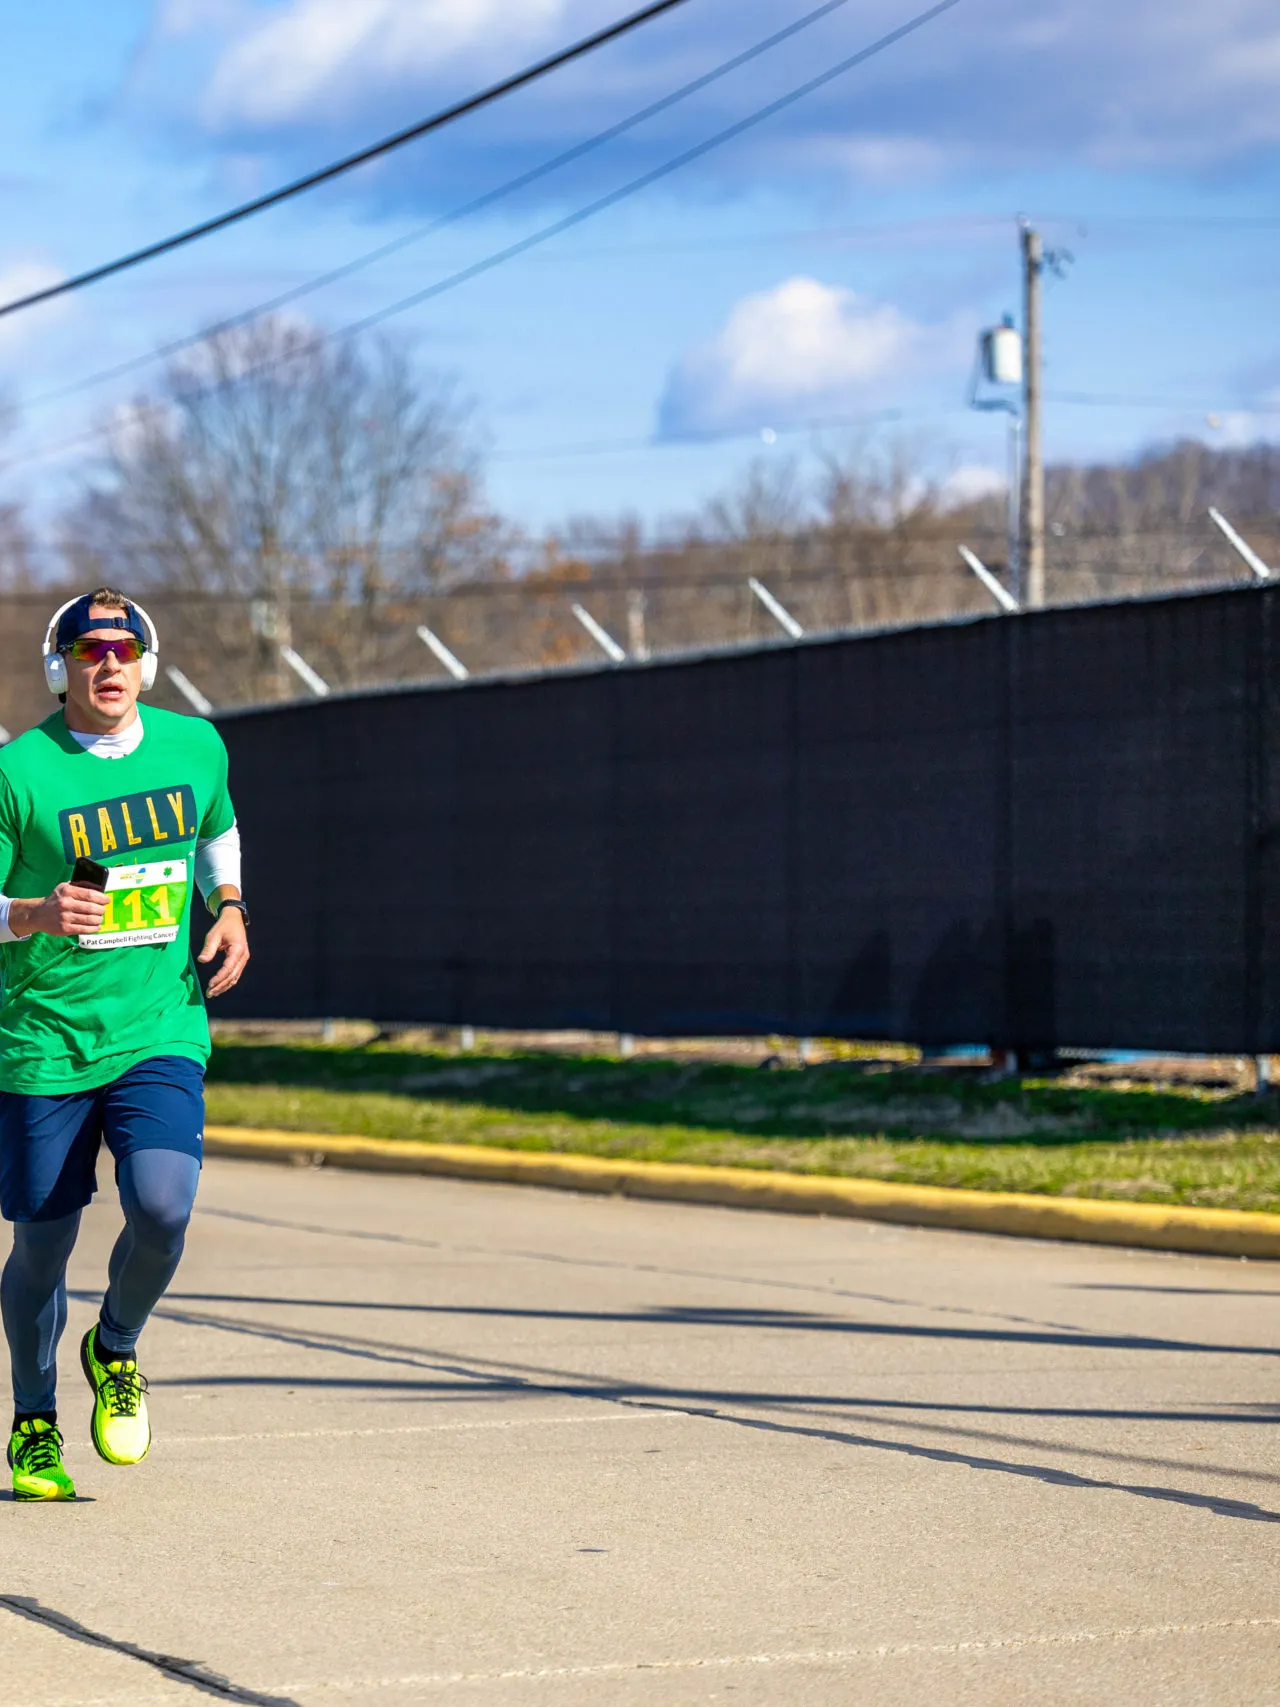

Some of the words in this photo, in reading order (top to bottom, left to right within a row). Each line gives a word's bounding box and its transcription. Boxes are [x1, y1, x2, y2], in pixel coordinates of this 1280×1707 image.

[68, 792, 195, 858] RALLY.
[98, 937, 128, 945] Campbell
[128, 934, 152, 942] Fighting
